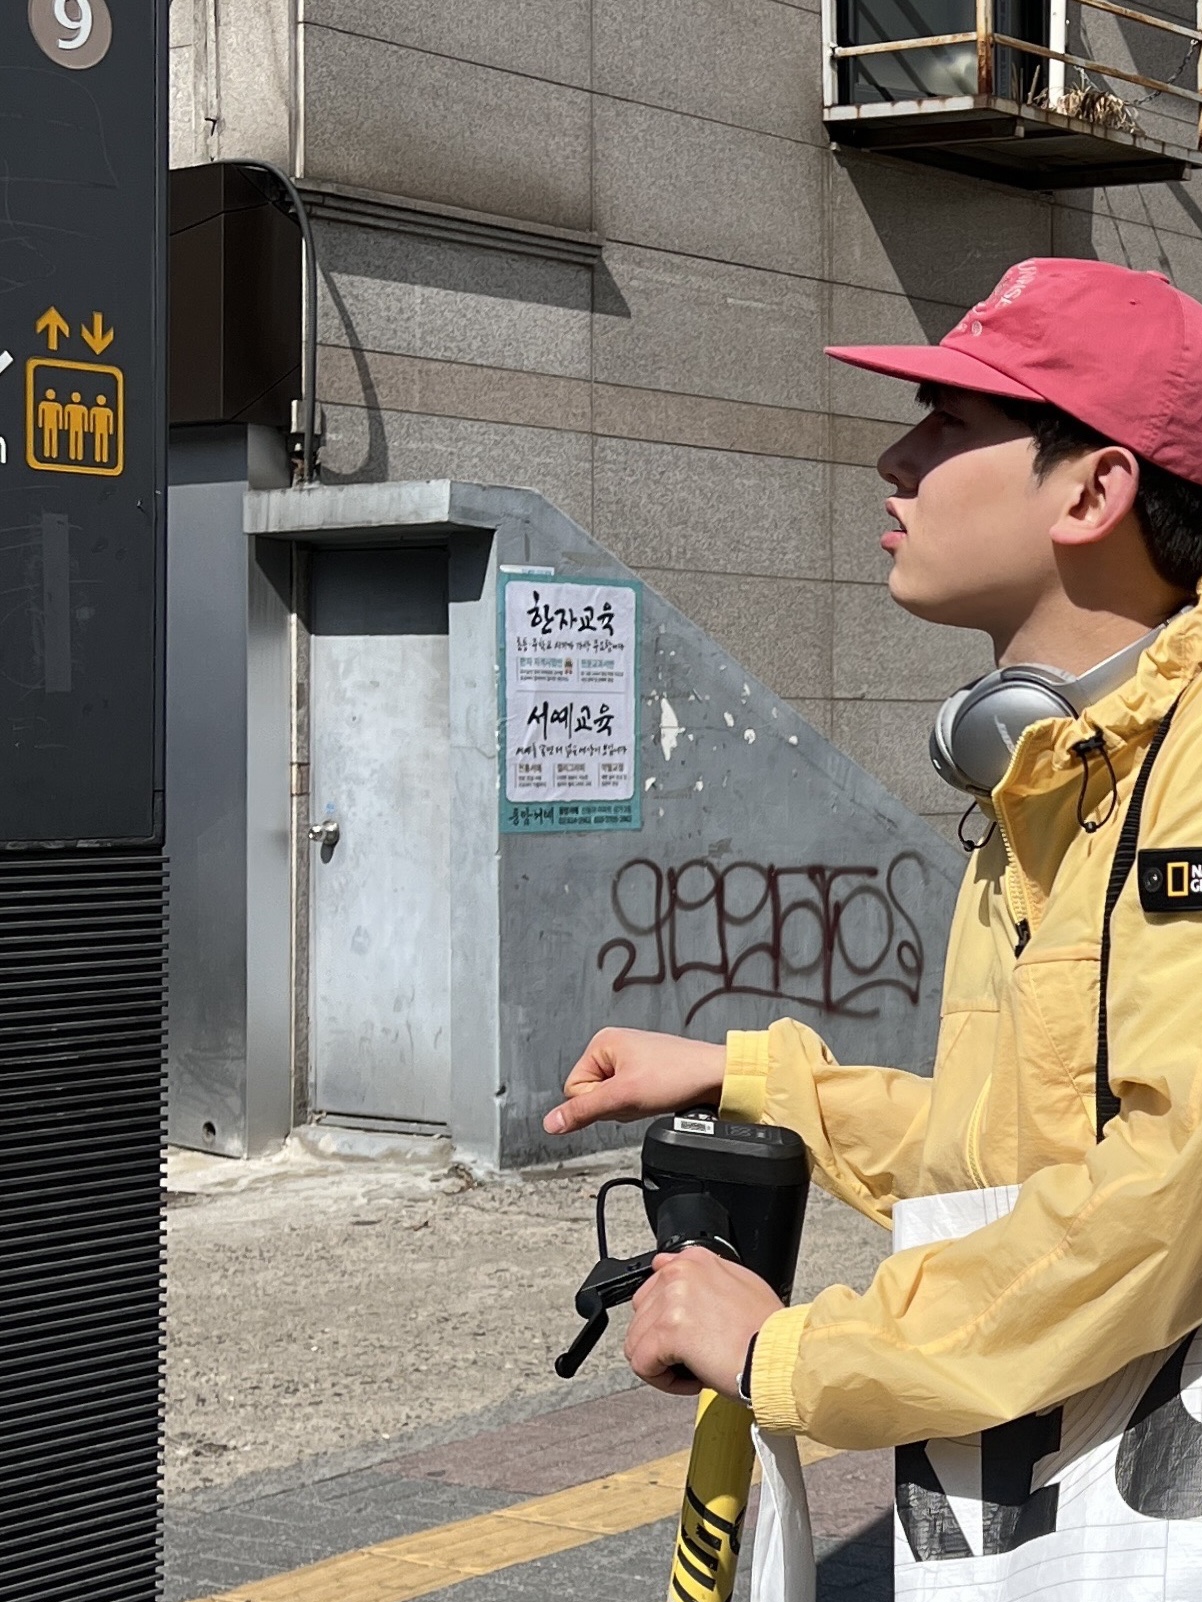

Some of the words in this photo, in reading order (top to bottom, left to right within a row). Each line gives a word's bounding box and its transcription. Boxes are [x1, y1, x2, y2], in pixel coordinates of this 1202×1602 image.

[52, 0, 94, 50] 9
[526, 590, 616, 636] 한자교육
[527, 701, 616, 740] 서예교육
